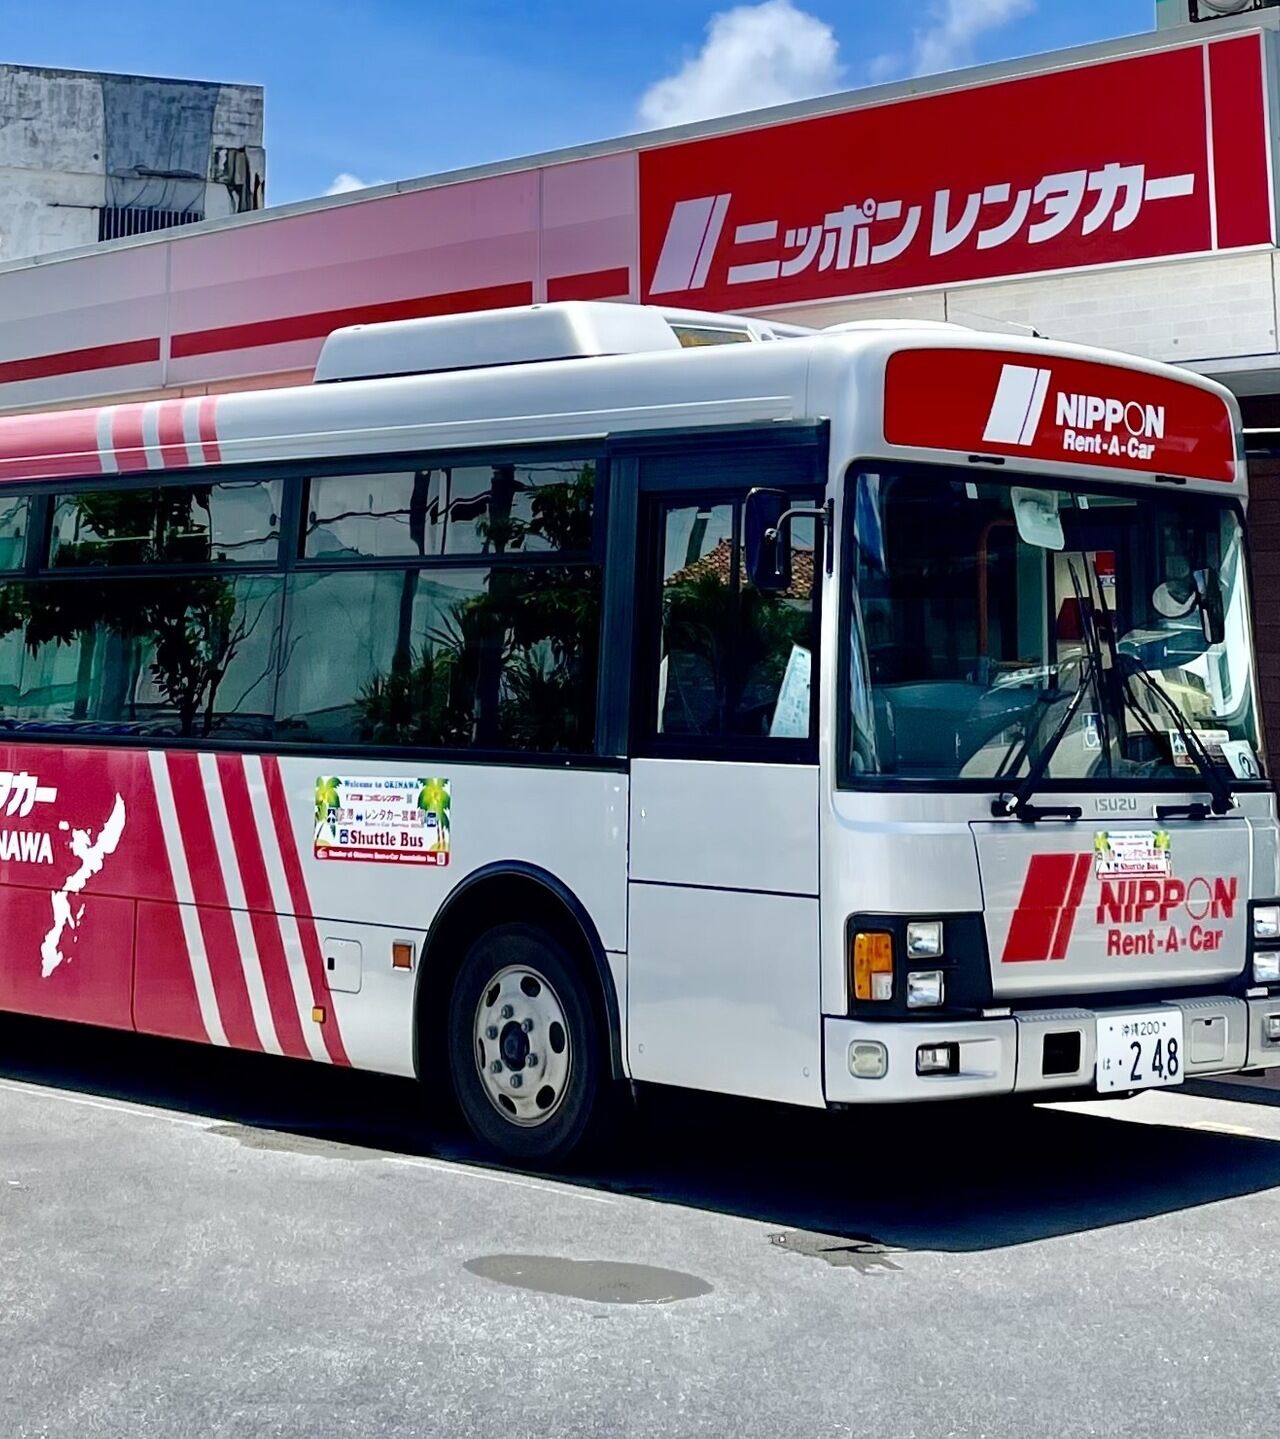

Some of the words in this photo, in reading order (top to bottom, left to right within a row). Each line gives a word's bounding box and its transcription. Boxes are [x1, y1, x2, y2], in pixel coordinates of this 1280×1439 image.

[726, 162, 1196, 286] ニッポンレンタカー
[1055, 391, 1165, 440] NIPPON
[1062, 428, 1156, 460] Rent-A-Car
[384, 780, 420, 790] OKINAWA
[1095, 797, 1137, 811] ISUZU
[350, 830, 397, 847] Shuttle
[400, 831, 424, 848] Bus
[1096, 877, 1238, 925] NIPPON
[1107, 925, 1223, 957] Rent-A-Car
